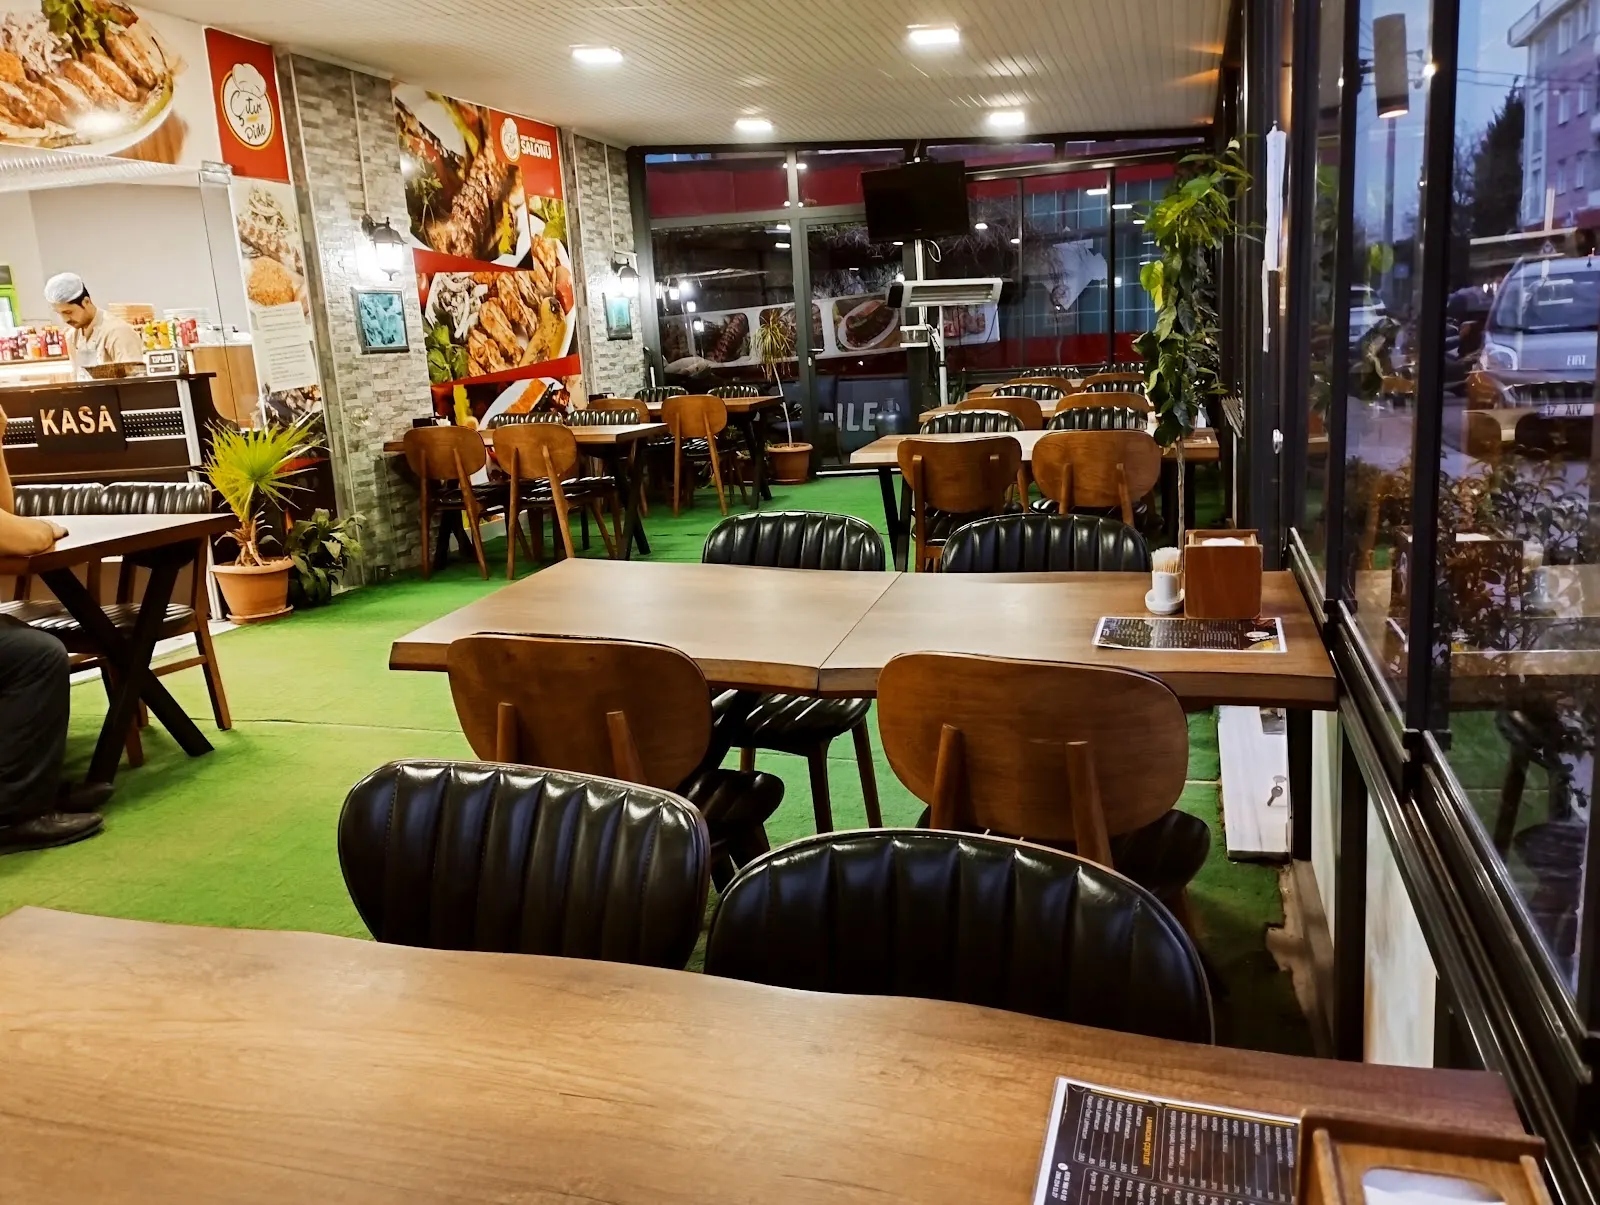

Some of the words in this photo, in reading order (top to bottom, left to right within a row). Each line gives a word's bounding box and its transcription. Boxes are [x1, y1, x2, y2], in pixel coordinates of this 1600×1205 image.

[520, 139, 552, 160] SALONU
[1567, 355, 1586, 366] FIAT
[39, 405, 117, 435] KASA
